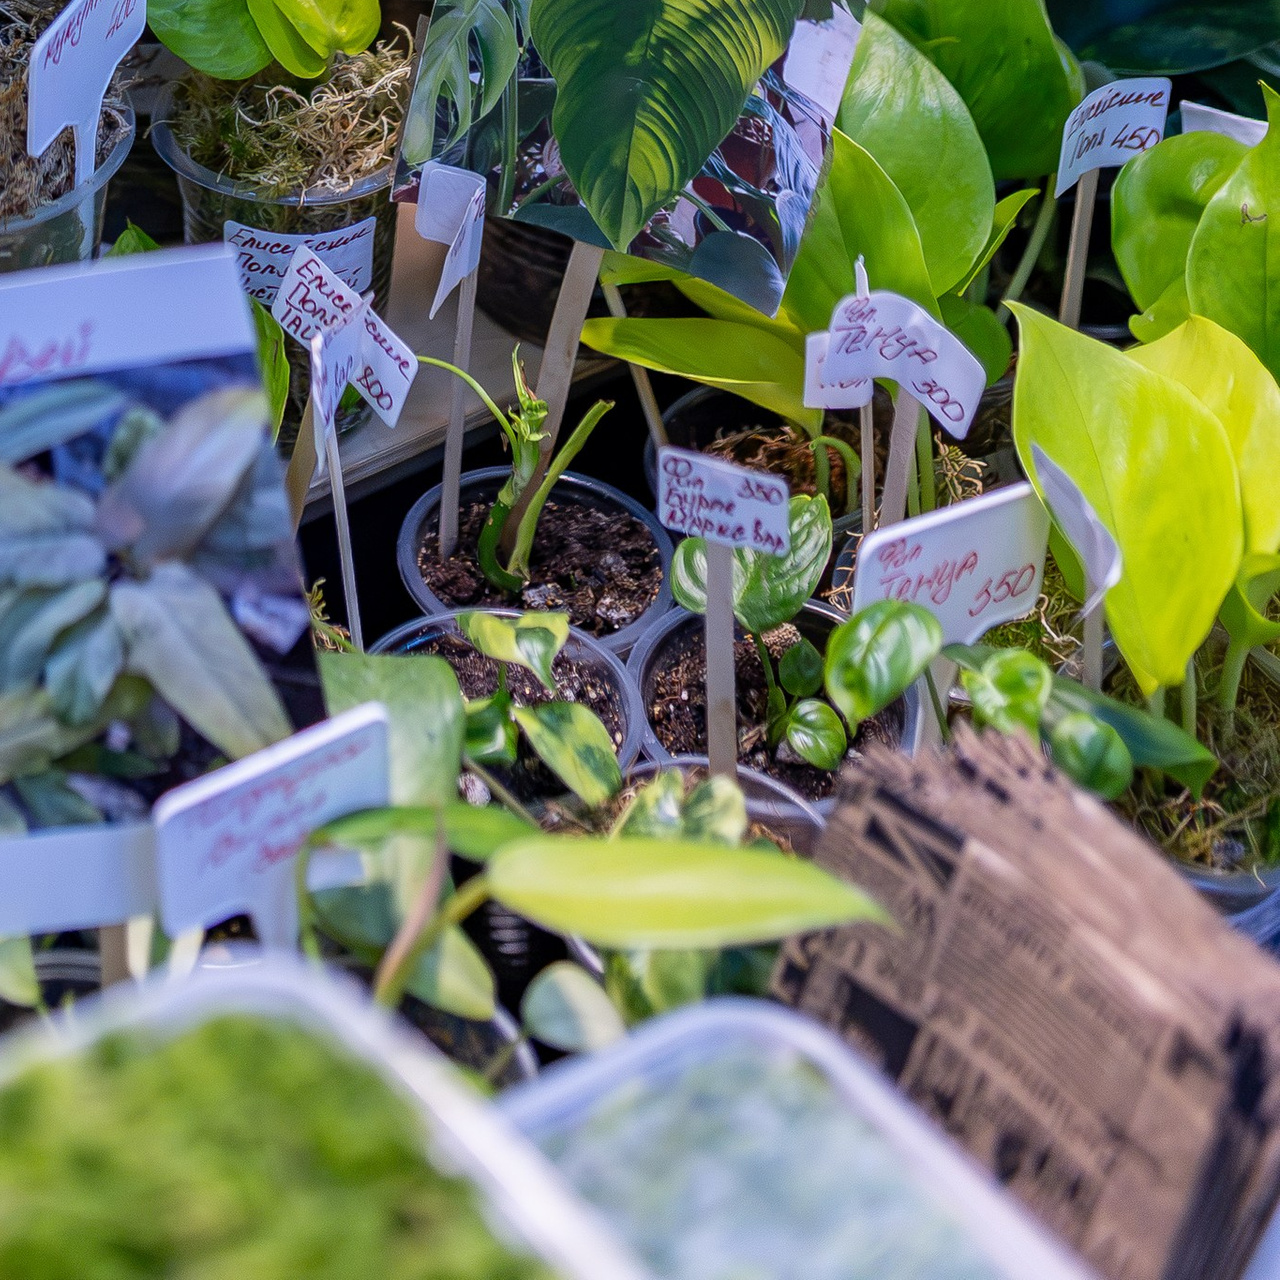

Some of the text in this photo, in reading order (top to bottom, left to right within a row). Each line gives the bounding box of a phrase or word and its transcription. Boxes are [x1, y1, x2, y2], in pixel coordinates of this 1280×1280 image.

[1111, 122, 1160, 154] 450
[356, 365, 394, 412] 800
[911, 377, 965, 422] 300
[968, 561, 1036, 618] 350
